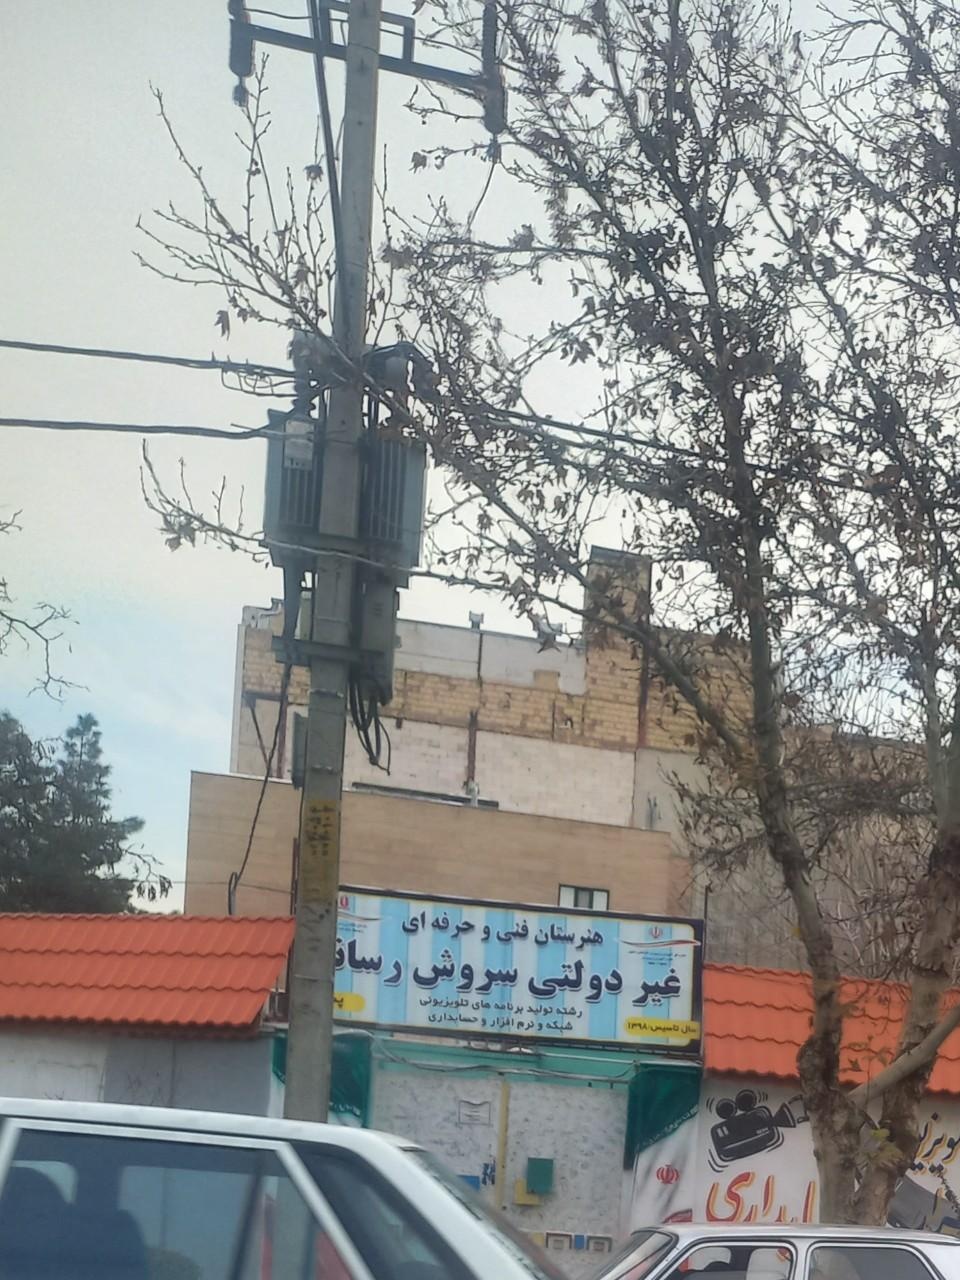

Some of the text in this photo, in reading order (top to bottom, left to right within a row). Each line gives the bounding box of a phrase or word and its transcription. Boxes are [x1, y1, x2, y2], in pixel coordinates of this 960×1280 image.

[402, 911, 604, 949] هنرستان فنی و حرفه ای
[413, 949, 518, 992] سروش
[528, 959, 623, 1001] دولتی
[632, 968, 682, 1005] غیر
[471, 999, 492, 1011] های
[494, 1001, 524, 1014] برنامه
[527, 1003, 553, 1016] تولید
[556, 1005, 583, 1018] رشته
[428, 1011, 479, 1024] حسابداری
[490, 1016, 515, 1029] افزار
[516, 1020, 535, 1031] نرم
[546, 1020, 573, 1034] شبکه
